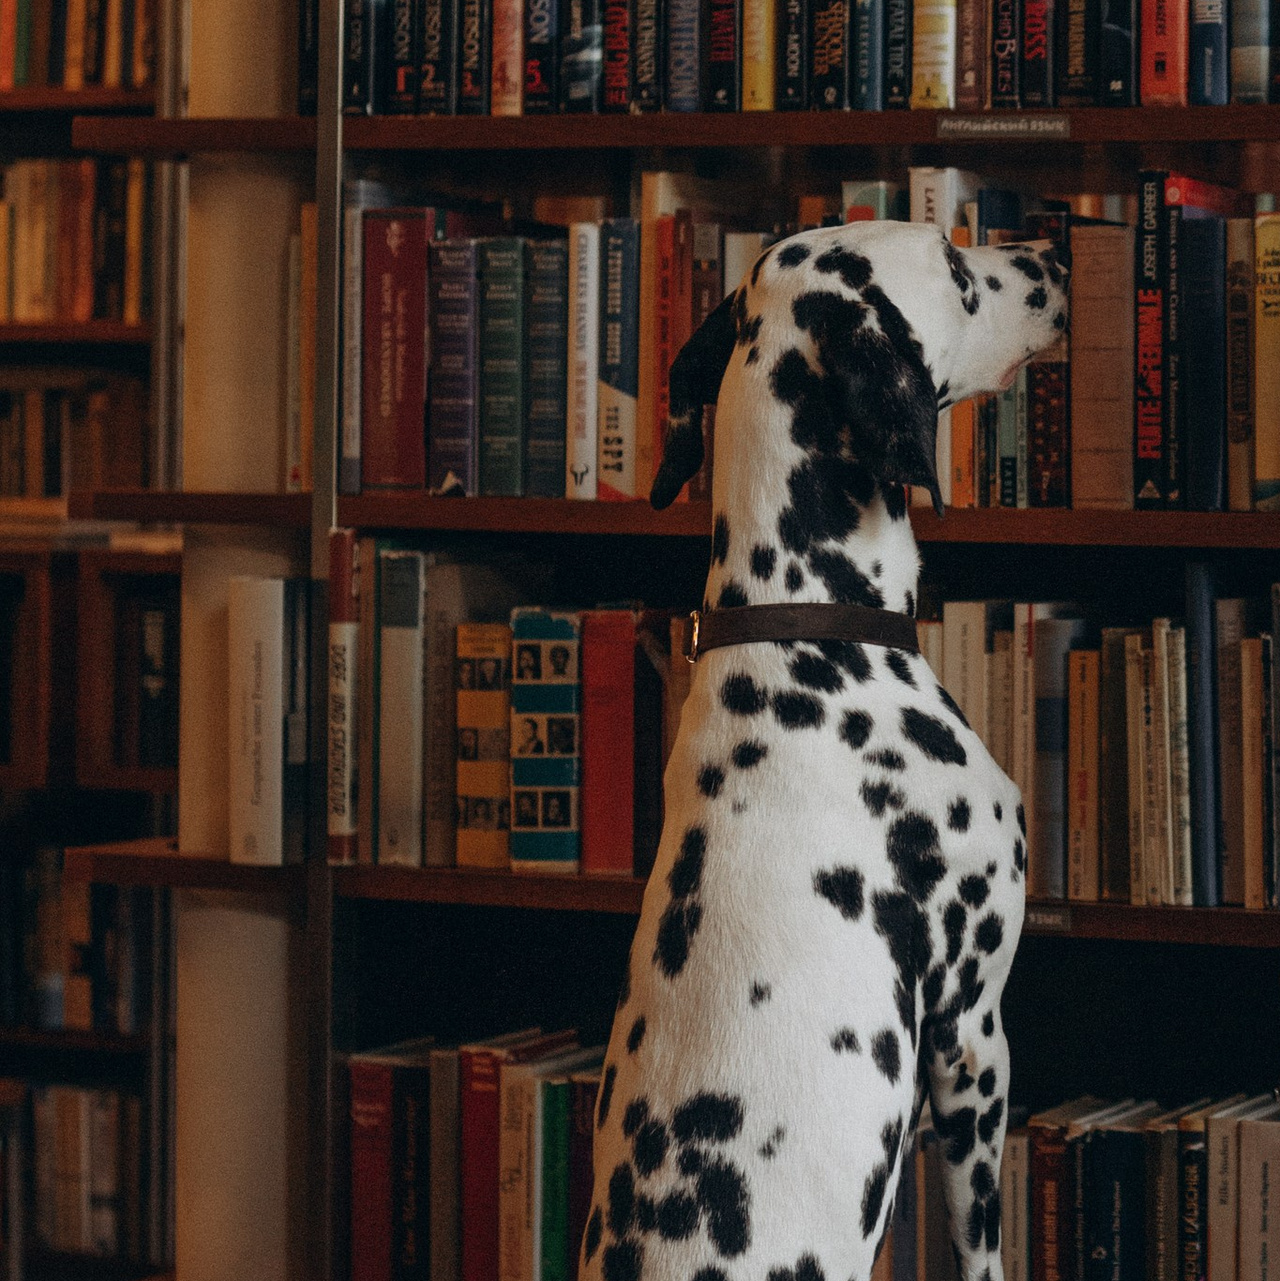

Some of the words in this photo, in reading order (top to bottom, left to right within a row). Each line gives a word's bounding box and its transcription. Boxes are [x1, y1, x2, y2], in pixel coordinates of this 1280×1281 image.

[605, 6, 629, 51] BAD
[710, 9, 735, 62] WATCH
[814, 11, 829, 75] HUNTER
[889, 0, 905, 45] FATAL
[1067, 13, 1085, 75] WARNING
[605, 53, 629, 88] BIG
[671, 0, 699, 99] PATTERSON
[787, 35, 800, 77] MOON
[889, 46, 904, 78] TIDE
[1030, 120, 1065, 132] язык
[924, 187, 936, 223] LAKE
[1143, 181, 1157, 230] GARBER
[575, 234, 589, 298] CHARLES
[1143, 234, 1157, 281] JOSEPH
[1168, 248, 1178, 270] AND
[380, 272, 392, 314] HOPE
[1168, 271, 1178, 292] THE
[574, 300, 588, 352] HANDY
[1168, 293, 1178, 341] CLASSICS
[379, 320, 392, 418] ABANDONED
[604, 406, 620, 431] THE
[1141, 399, 1162, 459] FUITE
[603, 435, 623, 473] SPY
